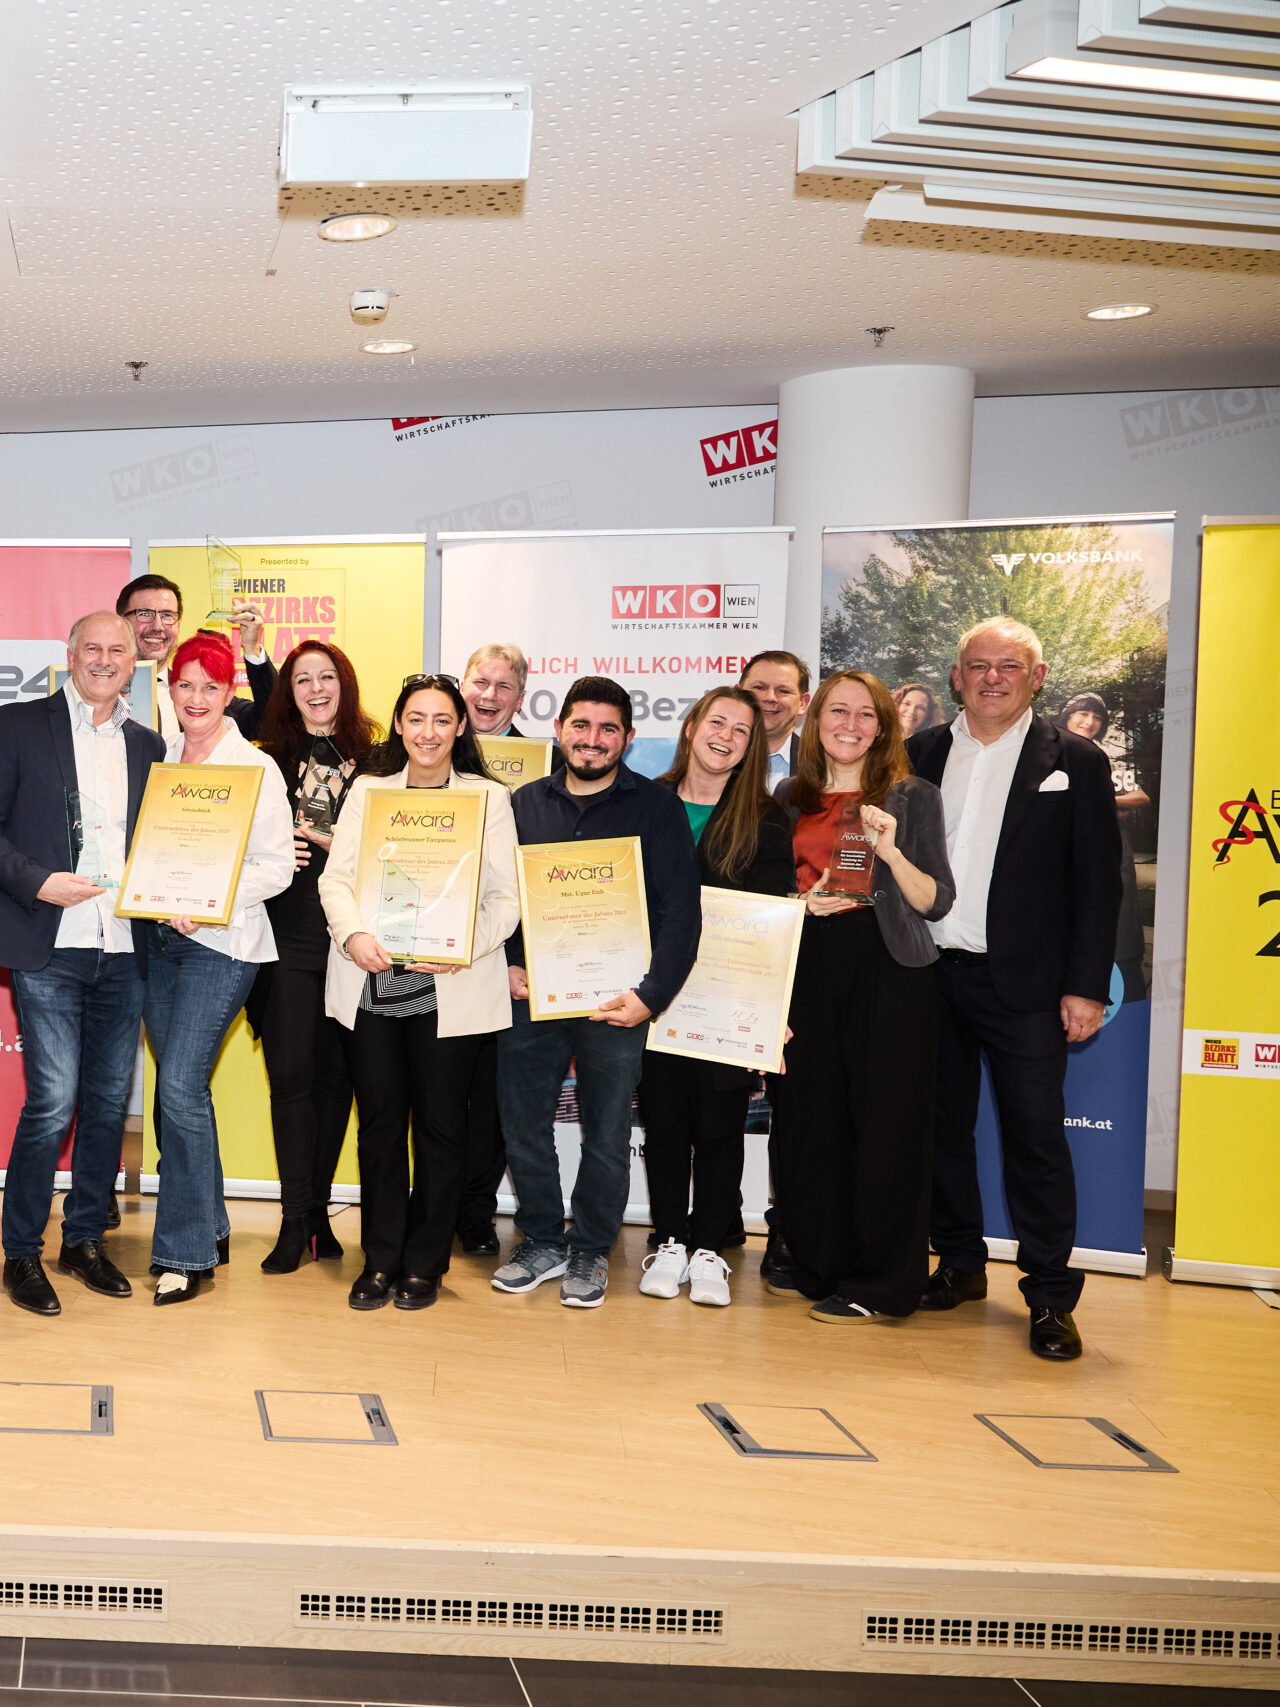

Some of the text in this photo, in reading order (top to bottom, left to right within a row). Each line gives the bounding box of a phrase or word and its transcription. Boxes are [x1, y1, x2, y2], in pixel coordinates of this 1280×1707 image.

[260, 558, 310, 567] Presented by
[1028, 550, 1144, 565] VOLKSBANK
[233, 578, 286, 594] WIENER
[614, 588, 756, 614] WKO WIEN
[611, 622, 758, 630] WIRTSCHAFTSKAMMER WIEN
[170, 782, 232, 800] Award
[390, 809, 455, 828] Award
[546, 861, 614, 883] Award
[1204, 1043, 1237, 1053] BEZIRKS
[1204, 1052, 1236, 1063] BLATT
